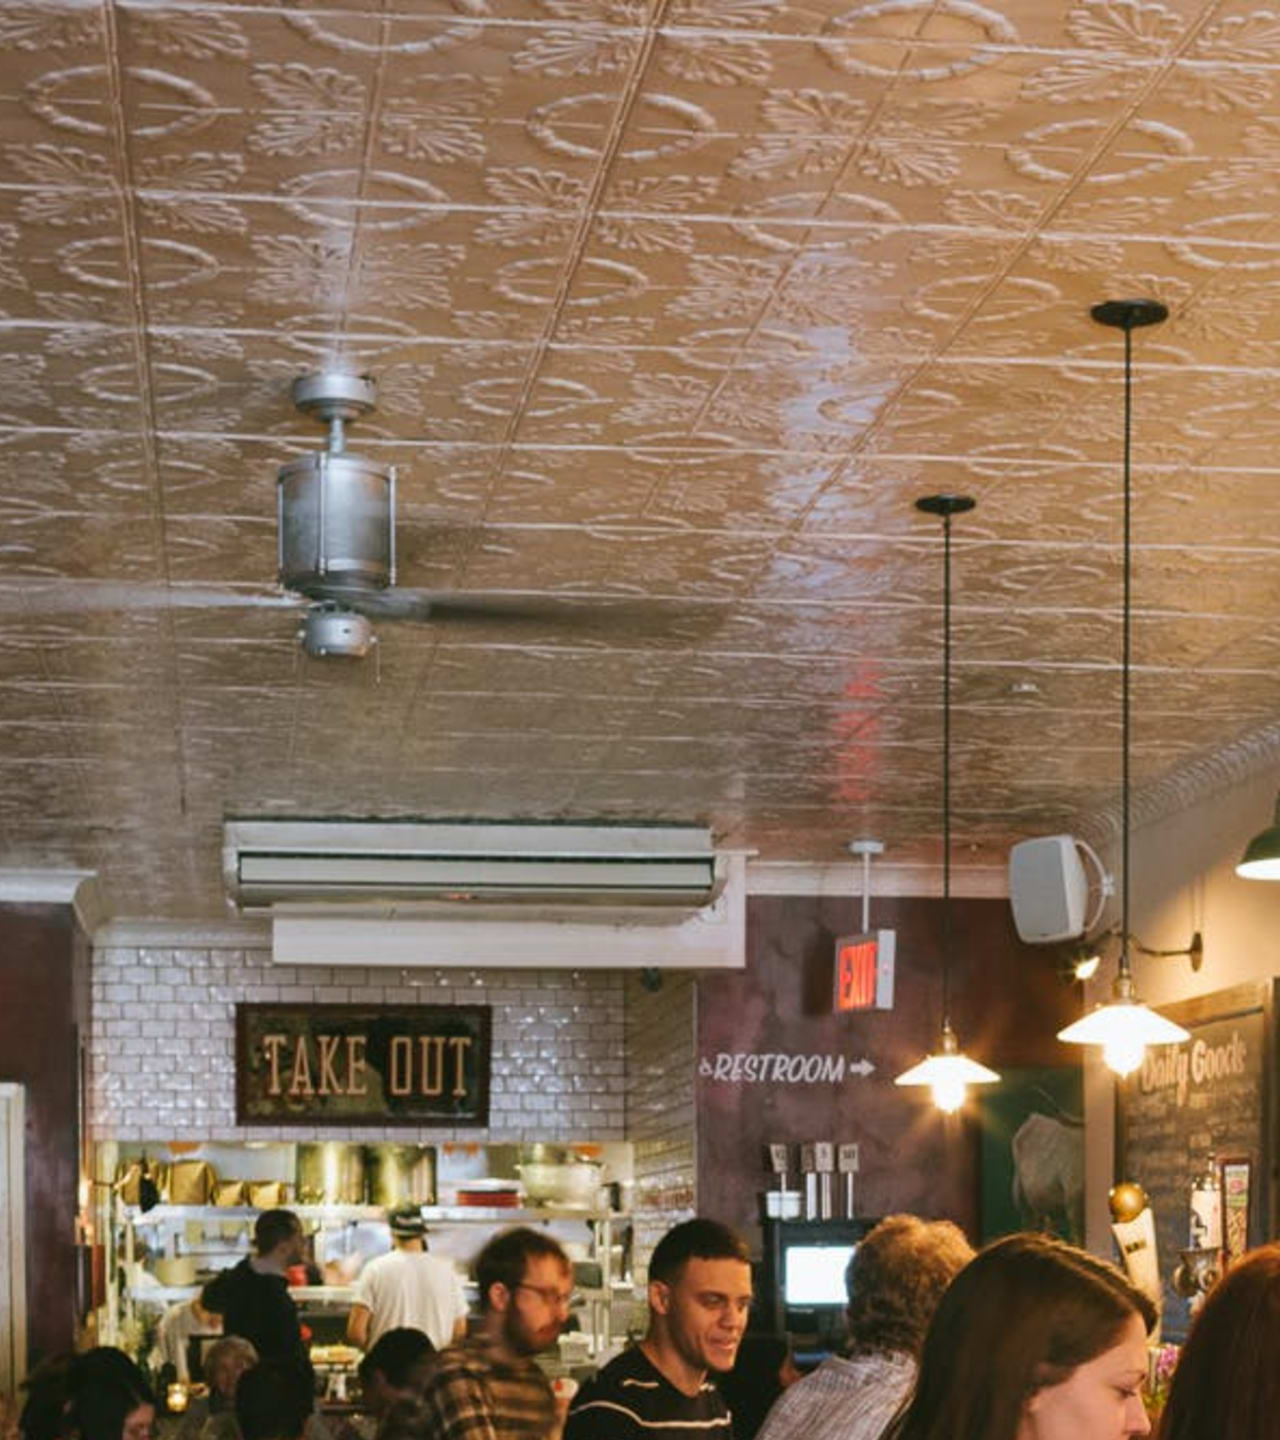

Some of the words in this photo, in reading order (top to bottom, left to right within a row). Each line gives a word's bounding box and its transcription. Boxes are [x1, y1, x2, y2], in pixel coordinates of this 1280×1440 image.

[838, 941, 877, 1009] EXIT
[263, 1034, 368, 1096] TAKE
[390, 1035, 472, 1096] OUT
[714, 1052, 846, 1083] RESTROOM
[1191, 1029, 1247, 1085] Goods
